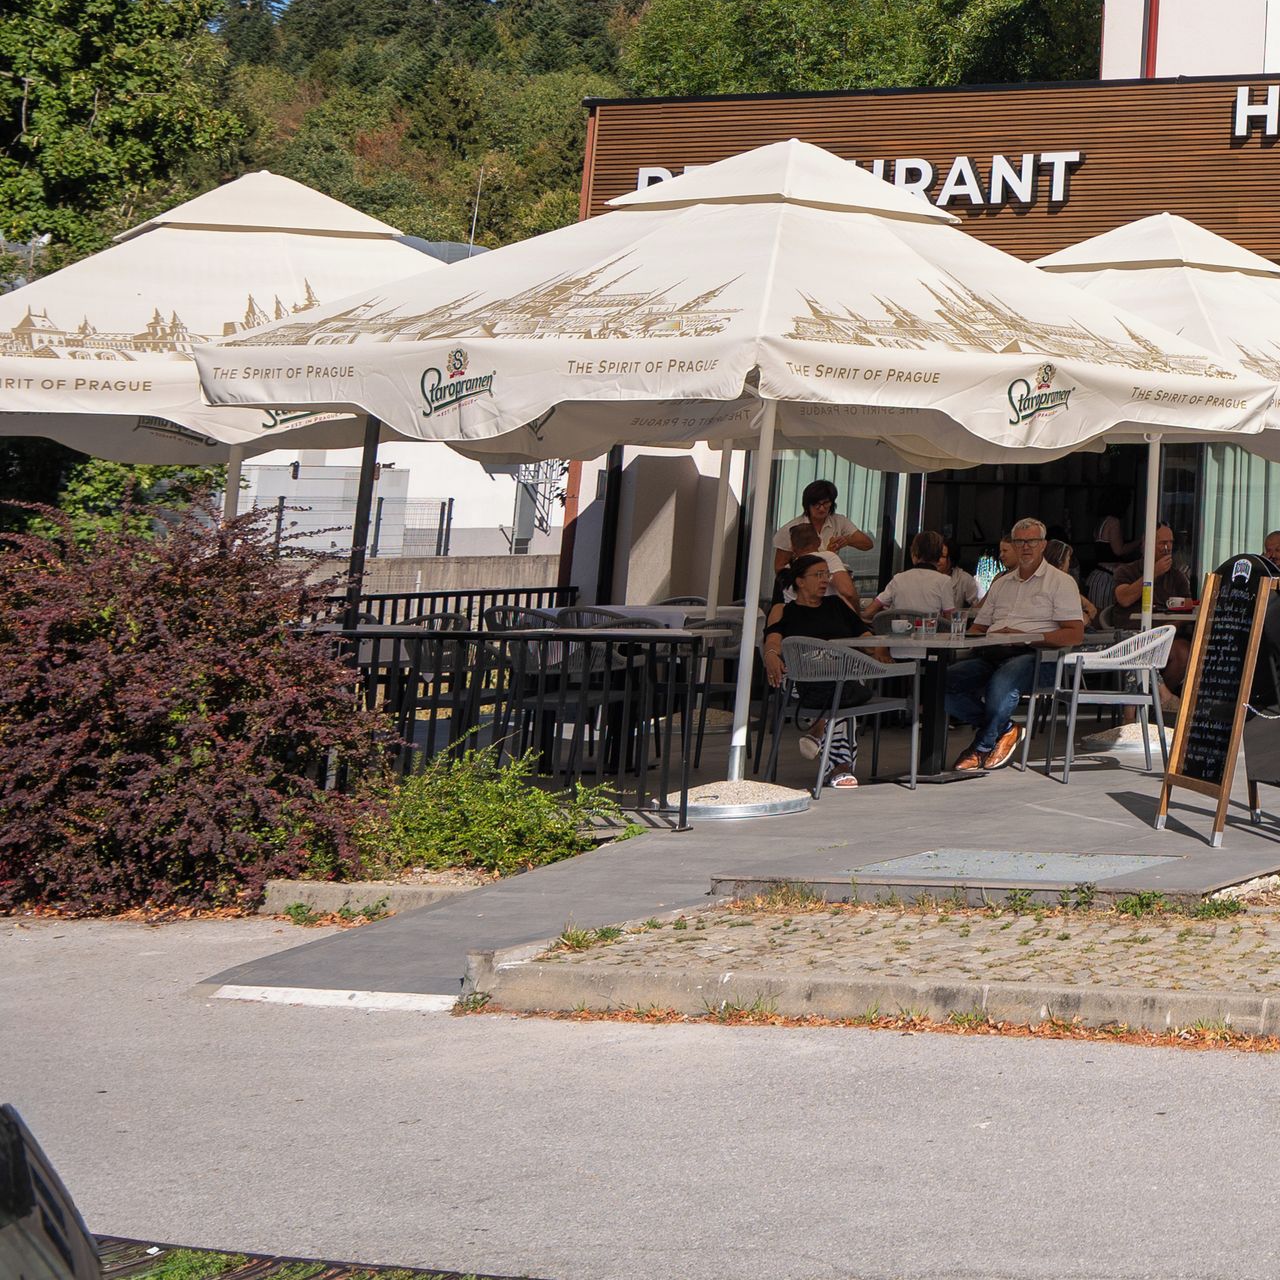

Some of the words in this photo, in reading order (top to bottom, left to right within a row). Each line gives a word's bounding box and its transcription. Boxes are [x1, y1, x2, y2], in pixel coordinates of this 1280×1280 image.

[213, 367, 239, 380] THE
[242, 366, 283, 380] SPIRIT
[286, 367, 302, 379] OF
[306, 365, 354, 379] PRAGUE
[568, 360, 593, 374] THE
[597, 359, 639, 374] SPIRIT
[644, 361, 663, 373] OF
[667, 359, 719, 373] PRAGUE
[786, 361, 810, 377] THE
[815, 364, 860, 380] SPIRIT
[863, 369, 883, 381] OF
[886, 368, 941, 384] PRAGUE
[41, 378, 66, 390] OF
[75, 378, 152, 391] PRAGUE
[421, 367, 494, 417] Staropramen
[1008, 378, 1072, 426] Staropramen
[1131, 386, 1152, 400] THE
[1154, 389, 1187, 404] SPIRIT
[1188, 394, 1203, 405] OF
[1205, 395, 1247, 410] PRAGUE
